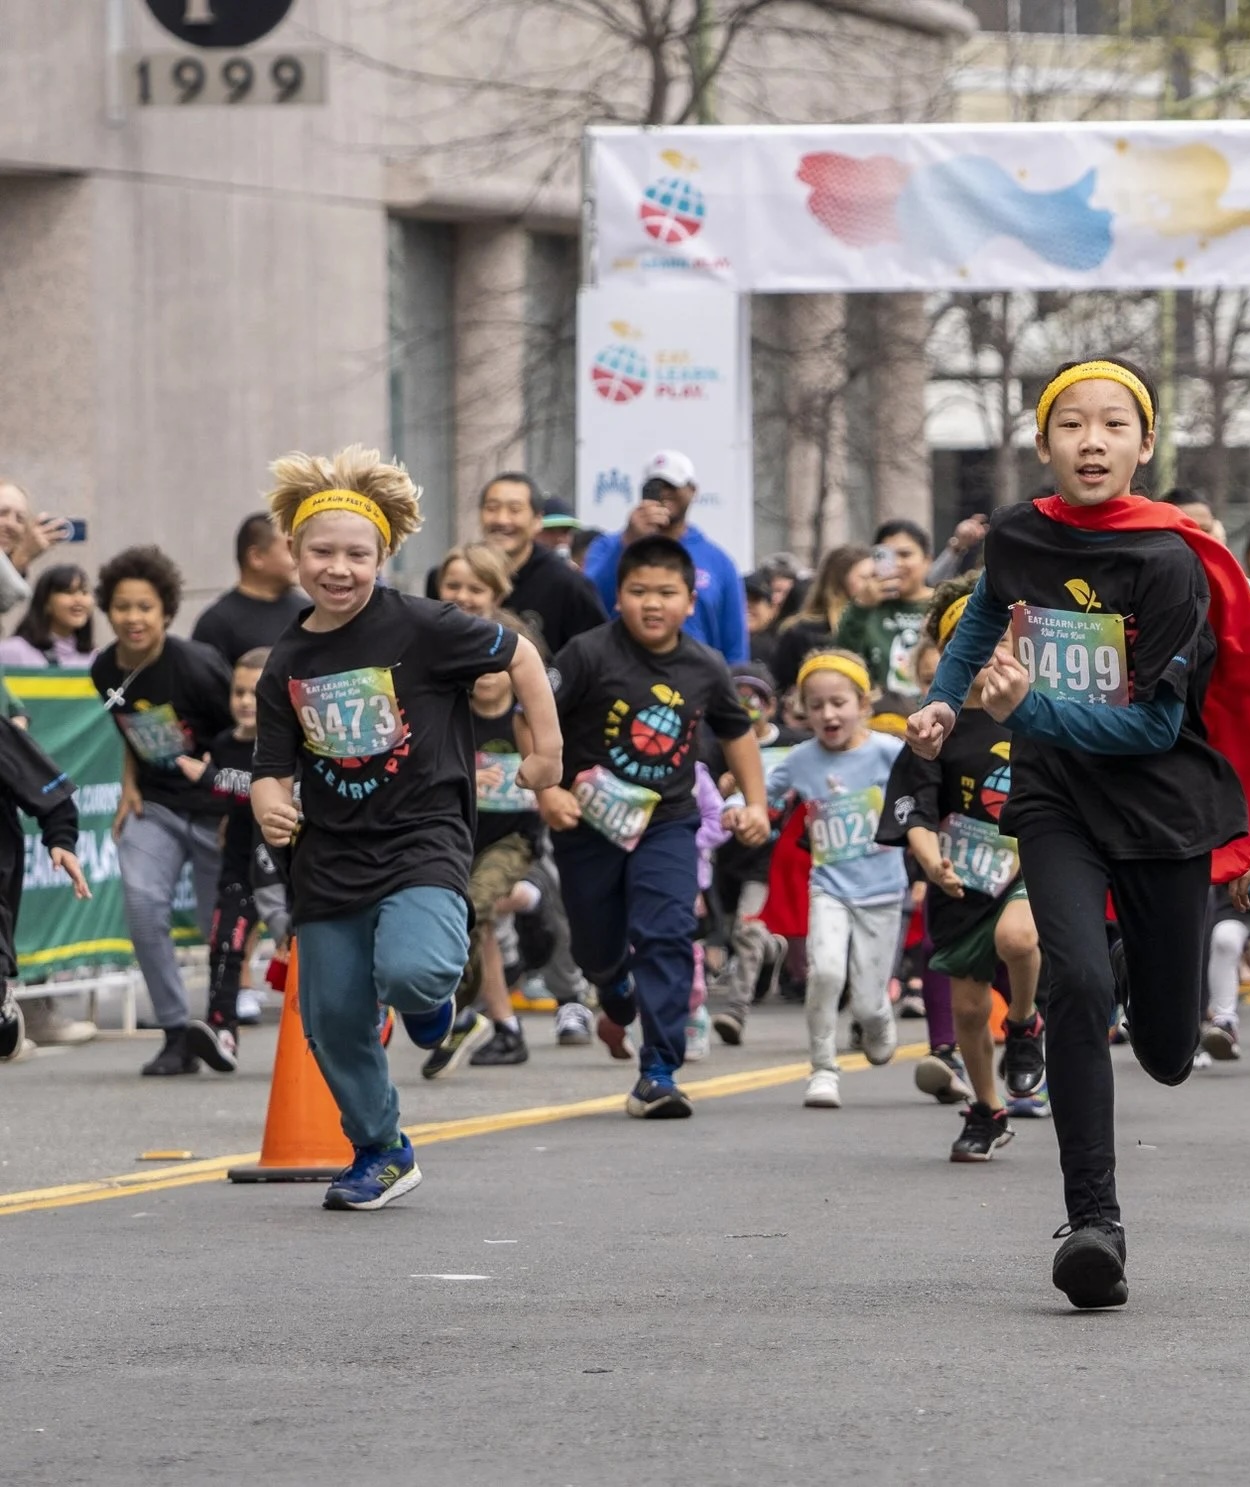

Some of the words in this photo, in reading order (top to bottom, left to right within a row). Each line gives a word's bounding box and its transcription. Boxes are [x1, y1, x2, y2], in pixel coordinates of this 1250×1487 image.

[136, 54, 304, 105] 1999
[1027, 615, 1105, 632] EAT.LEARN.PLAY.
[1018, 635, 1121, 692] 9499
[301, 694, 397, 742] 9473
[314, 758, 391, 800] LEARN.
